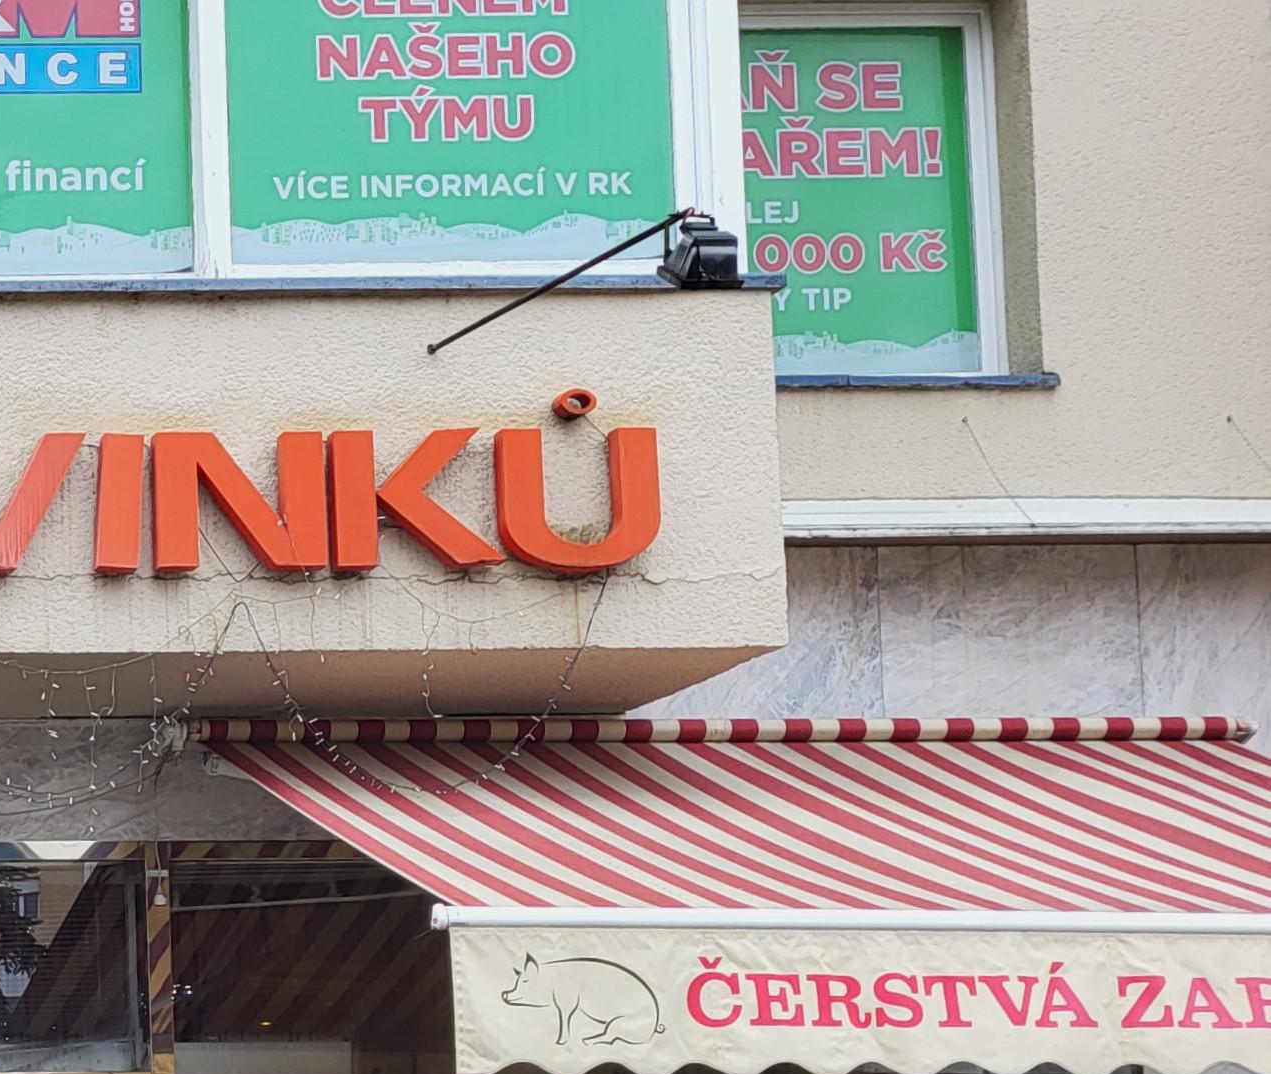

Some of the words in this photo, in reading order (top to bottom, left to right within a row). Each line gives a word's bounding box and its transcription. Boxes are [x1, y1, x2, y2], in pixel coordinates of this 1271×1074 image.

[315, 23, 575, 81] NAŠEHO
[817, 62, 903, 111] SE
[358, 85, 534, 142] TÝMU
[6, 158, 147, 191] financí
[273, 171, 349, 199] VÍCE
[360, 167, 544, 198] INFORMACÍ
[555, 173, 577, 196] V
[588, 172, 632, 195] RK
[802, 288, 852, 311] TIP
[686, 955, 1099, 1029] ČERSTVÁ
